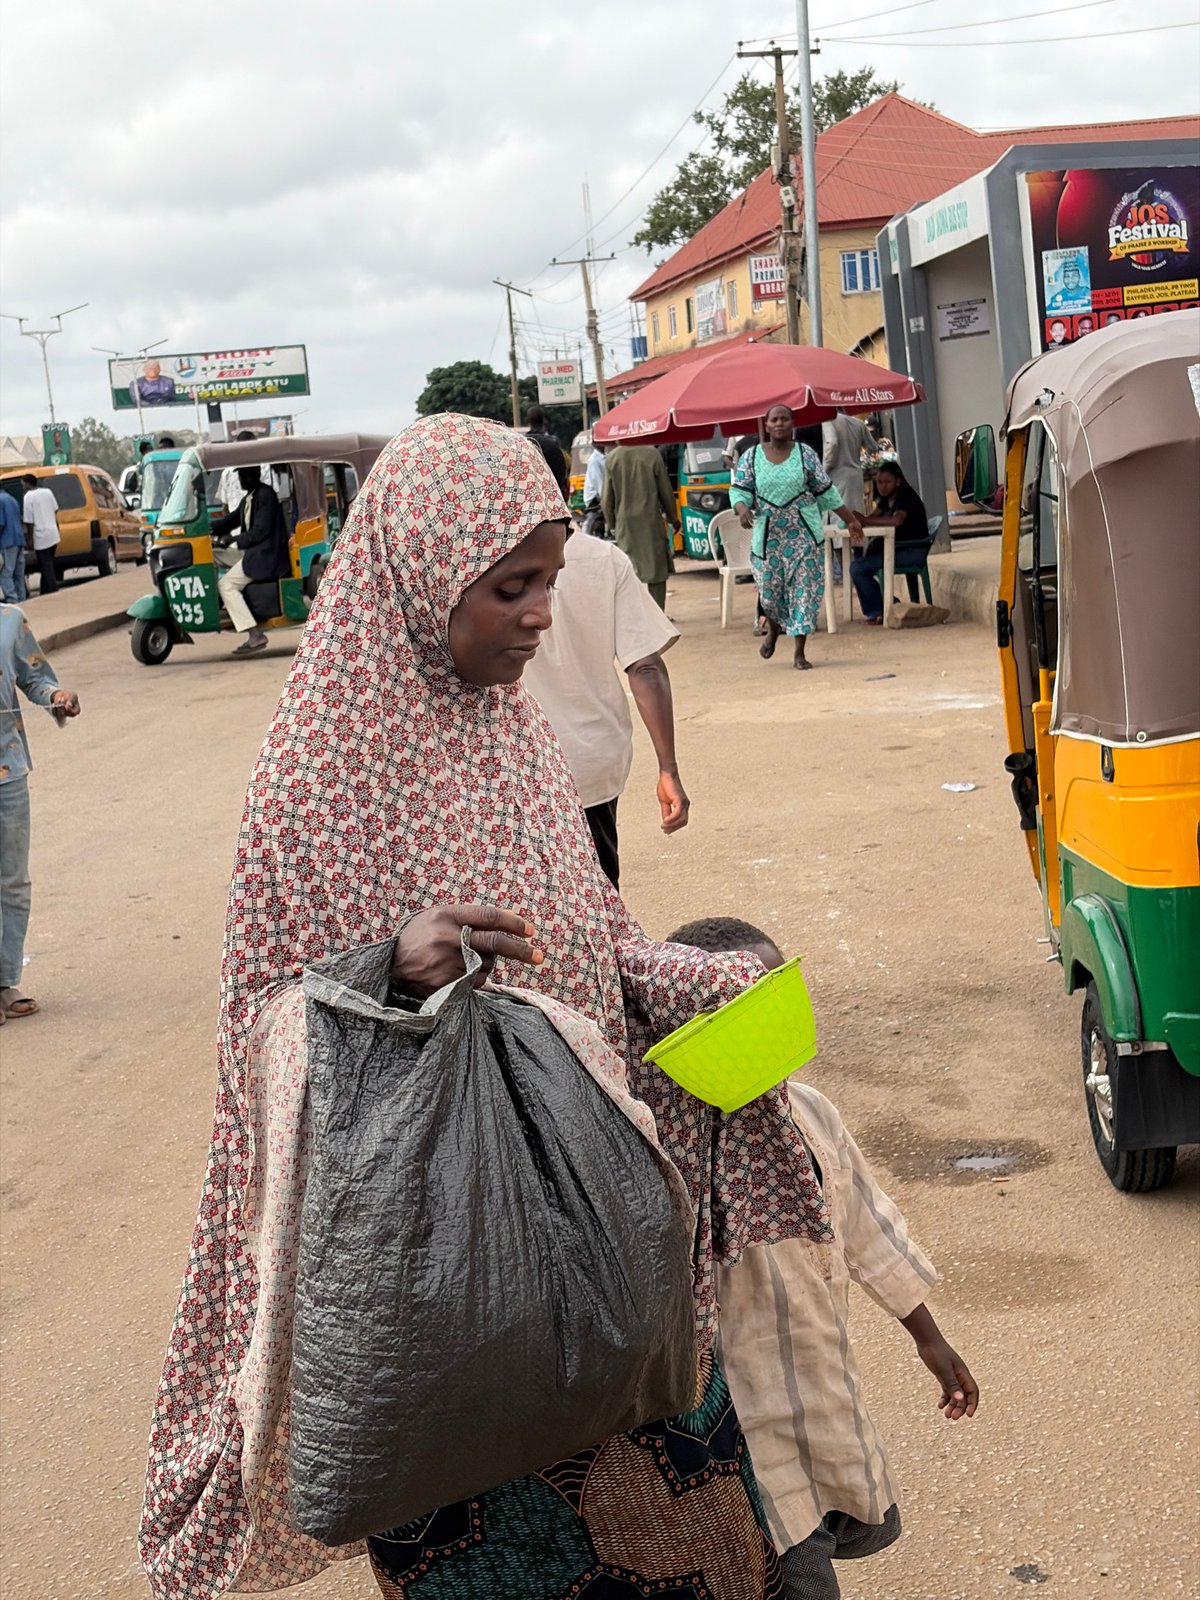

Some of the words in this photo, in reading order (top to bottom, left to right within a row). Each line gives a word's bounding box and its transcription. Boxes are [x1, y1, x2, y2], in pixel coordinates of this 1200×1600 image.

[1126, 203, 1170, 229] JOS
[1108, 219, 1188, 249] Festival
[1128, 241, 1147, 249] PRAISE
[1152, 239, 1178, 247] WORSHIP
[1170, 289, 1197, 297] PLATEAU
[542, 366, 553, 375] LA
[556, 365, 575, 374] MED
[541, 375, 576, 387] PHARMACY
[855, 387, 870, 403] All
[869, 387, 894, 402] Stars
[626, 420, 639, 436] All
[639, 419, 657, 434] Stars
